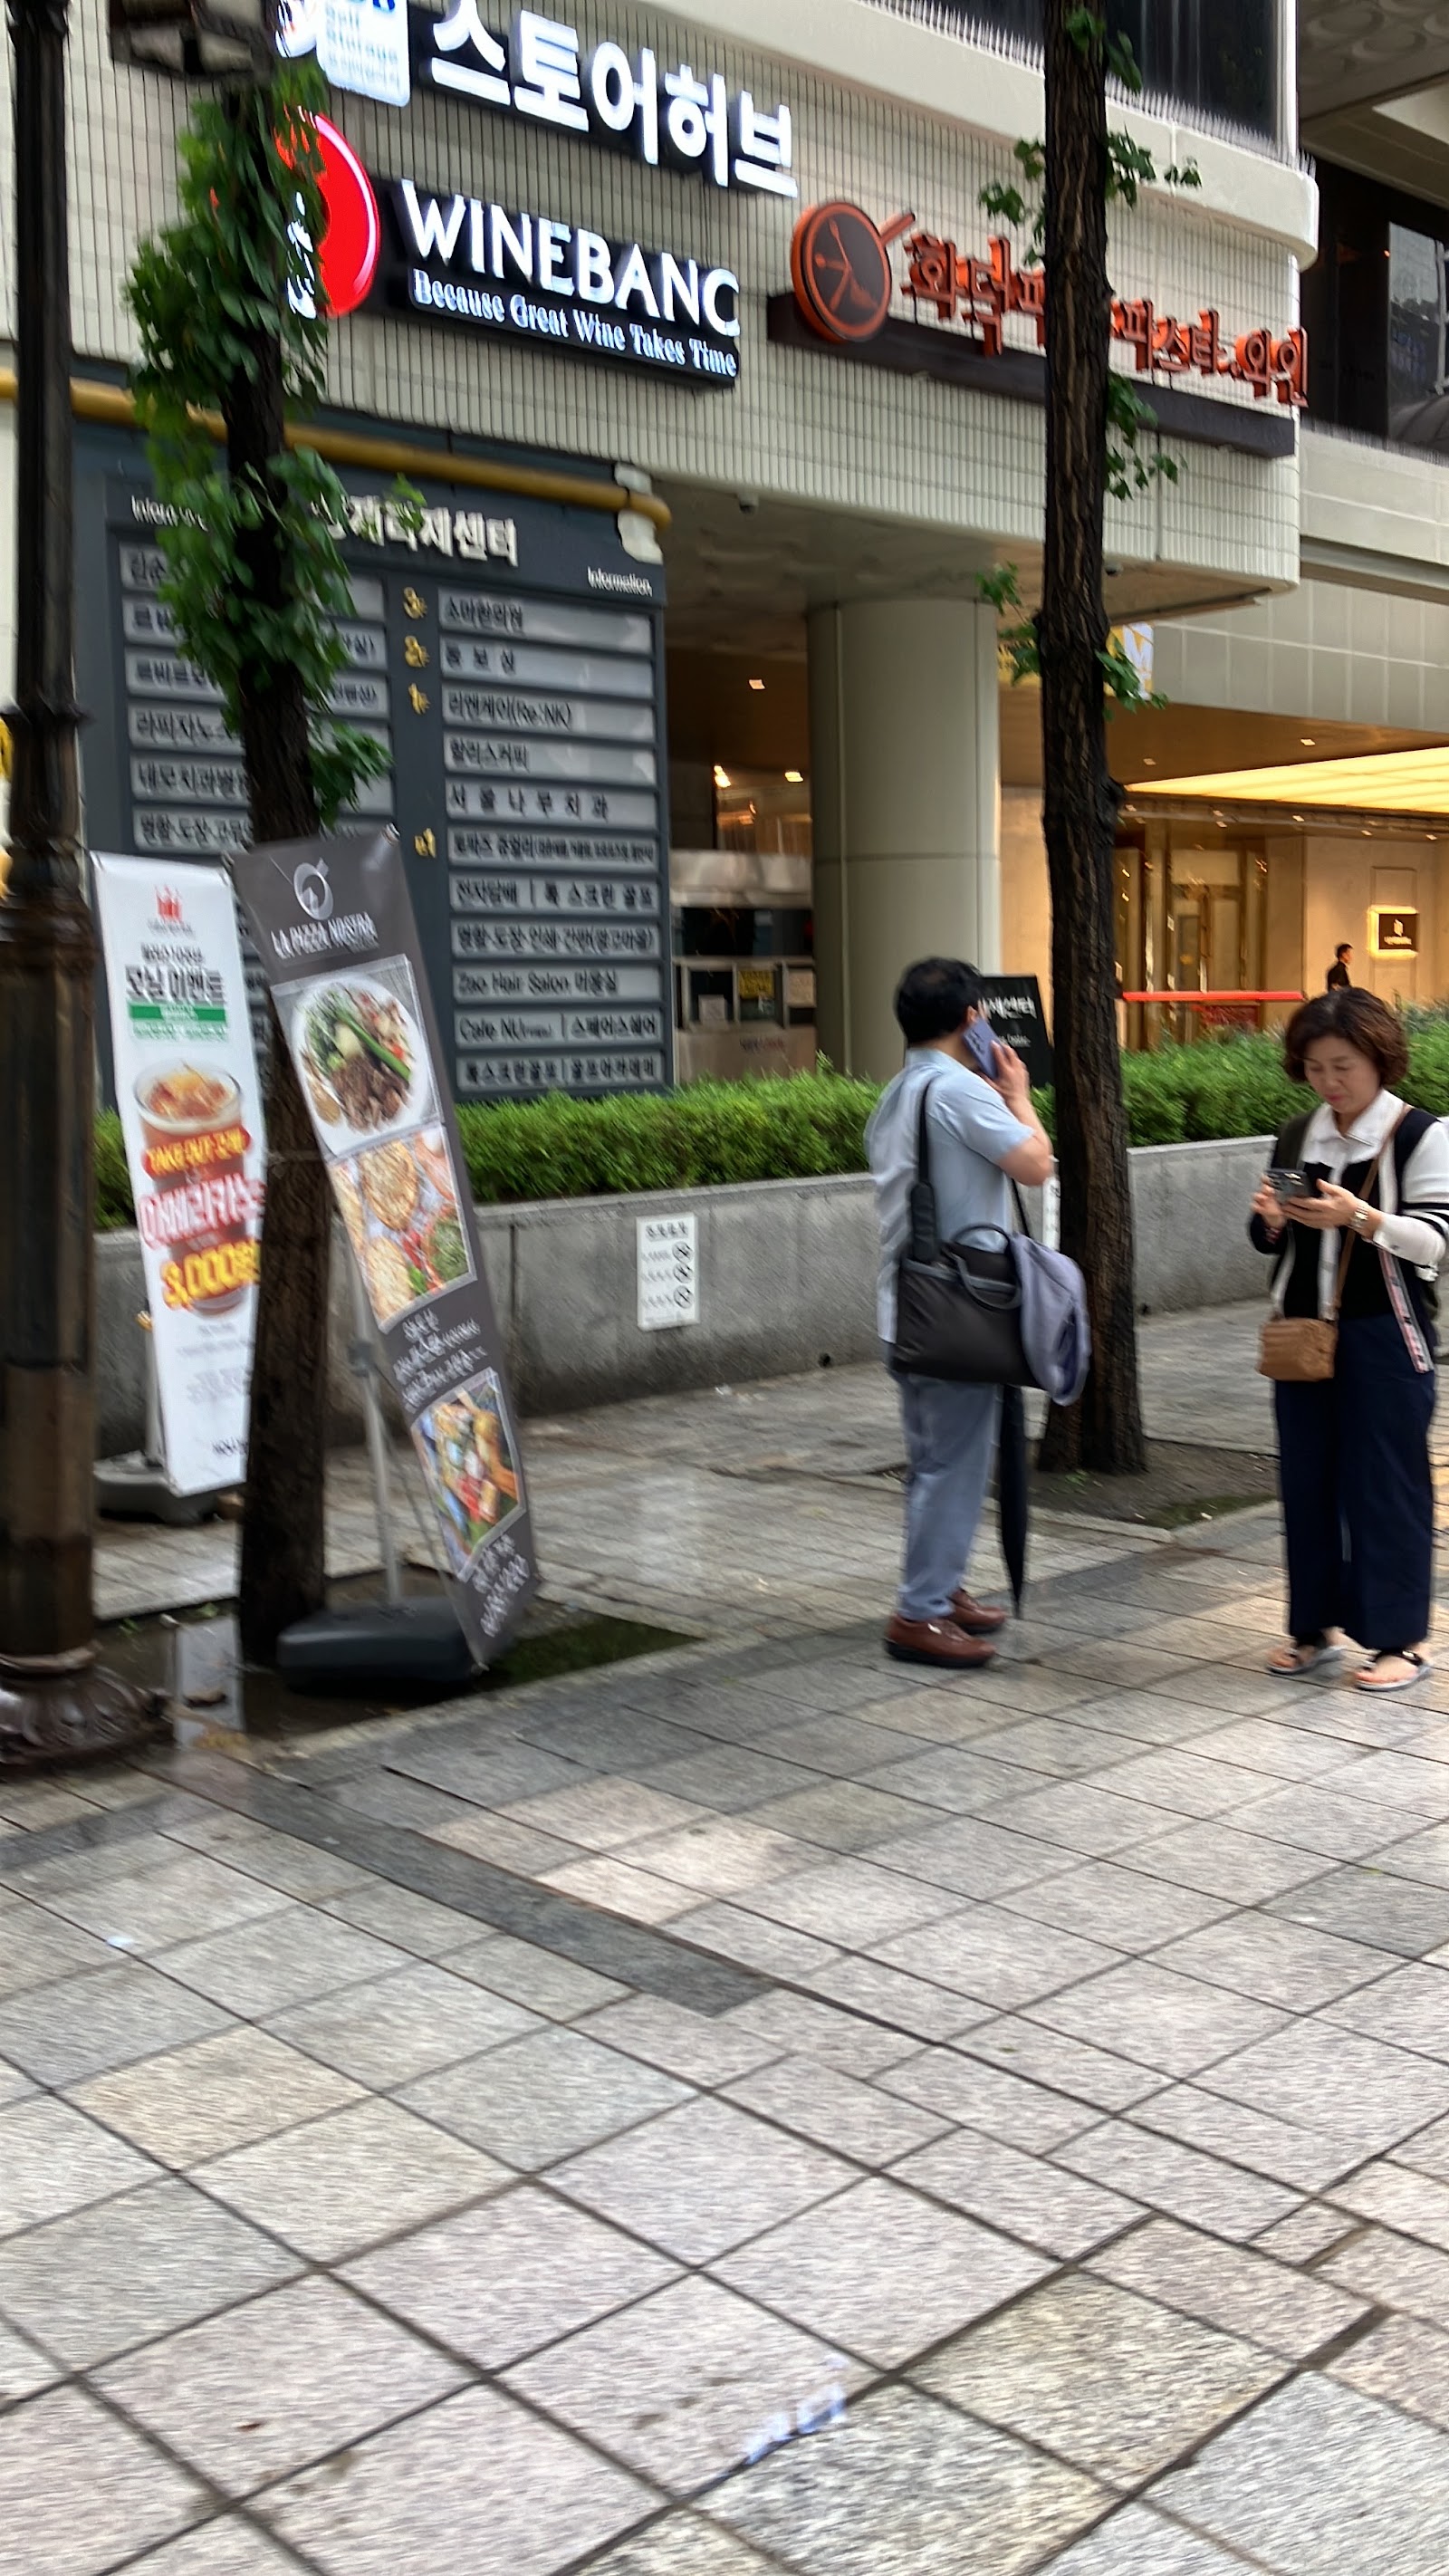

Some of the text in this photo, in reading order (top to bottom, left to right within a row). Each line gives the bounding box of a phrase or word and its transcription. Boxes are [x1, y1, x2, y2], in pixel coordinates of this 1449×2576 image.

[431, 0, 798, 197] 스토어허브
[400, 178, 741, 337] WINEBANC
[414, 270, 737, 377] Because Great Wine Takes Time
[587, 566, 653, 598] Information
